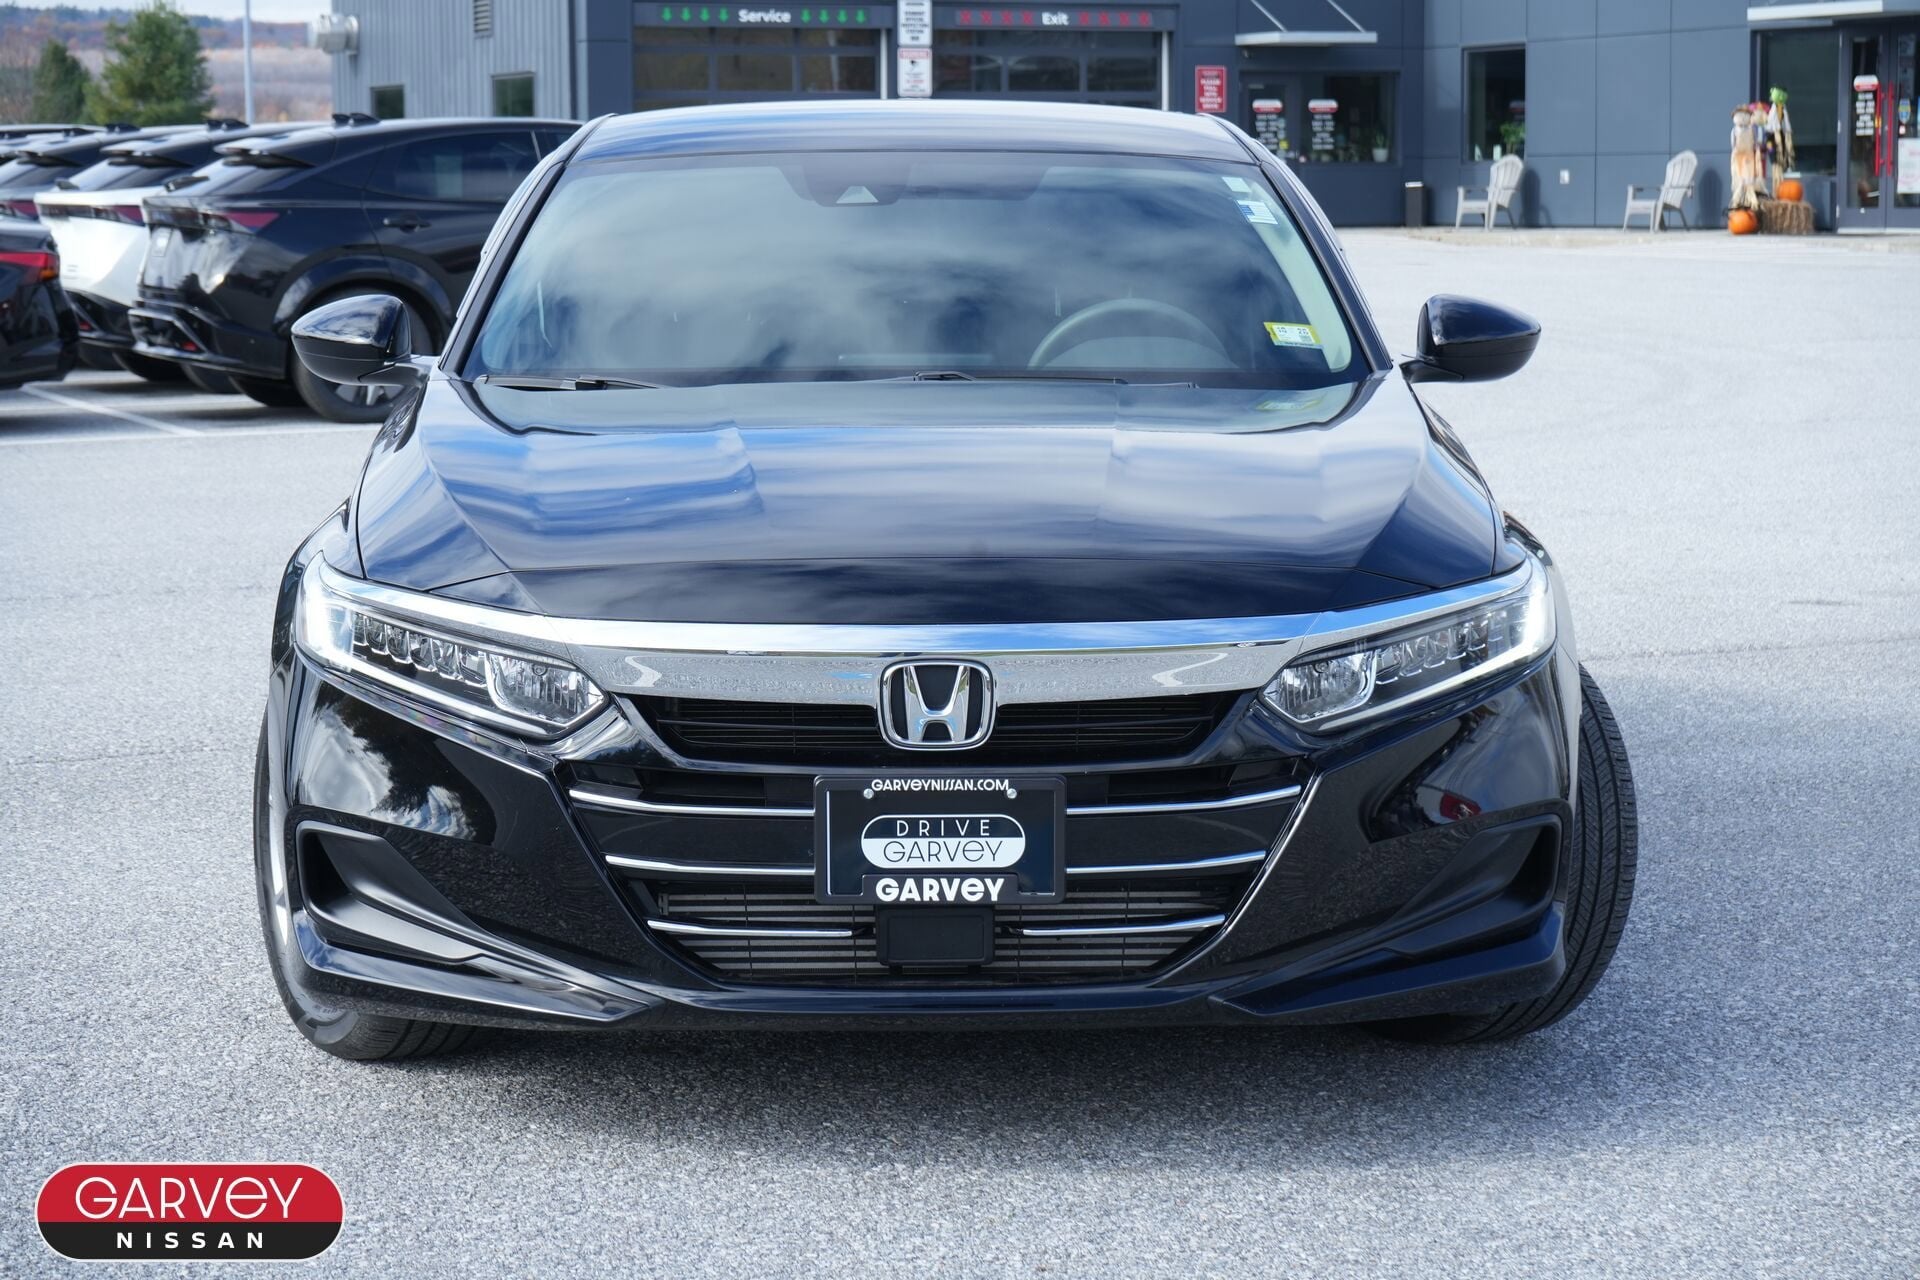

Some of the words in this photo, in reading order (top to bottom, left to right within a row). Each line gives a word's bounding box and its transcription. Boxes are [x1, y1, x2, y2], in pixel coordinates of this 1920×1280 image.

[738, 8, 792, 23] Service
[1041, 11, 1069, 26] Exit
[896, 819, 990, 837] DRIVE
